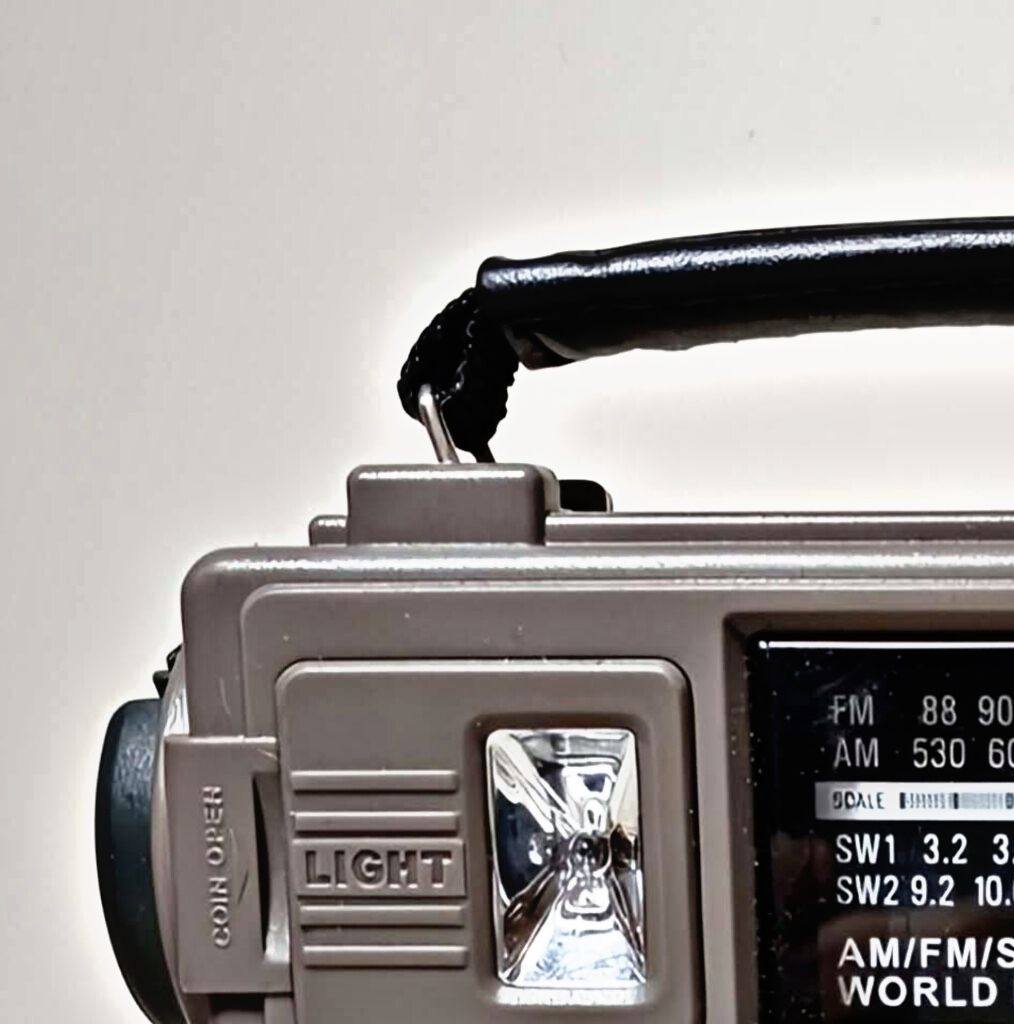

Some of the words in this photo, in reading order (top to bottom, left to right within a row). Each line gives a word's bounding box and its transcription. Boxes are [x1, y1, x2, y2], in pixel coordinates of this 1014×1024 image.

[832, 694, 874, 727] FM
[922, 694, 957, 727] 88
[978, 694, 1014, 727] 90
[833, 737, 879, 769] AM
[912, 737, 966, 770] 530
[202, 785, 224, 866] OPEN
[836, 833, 895, 866] SW1
[922, 833, 968, 866] 3.2
[305, 849, 453, 888] LIGHT
[836, 874, 900, 907] SW2
[910, 874, 955, 907] 9.2
[208, 877, 231, 947] COIN
[837, 975, 998, 1008] WORLD
